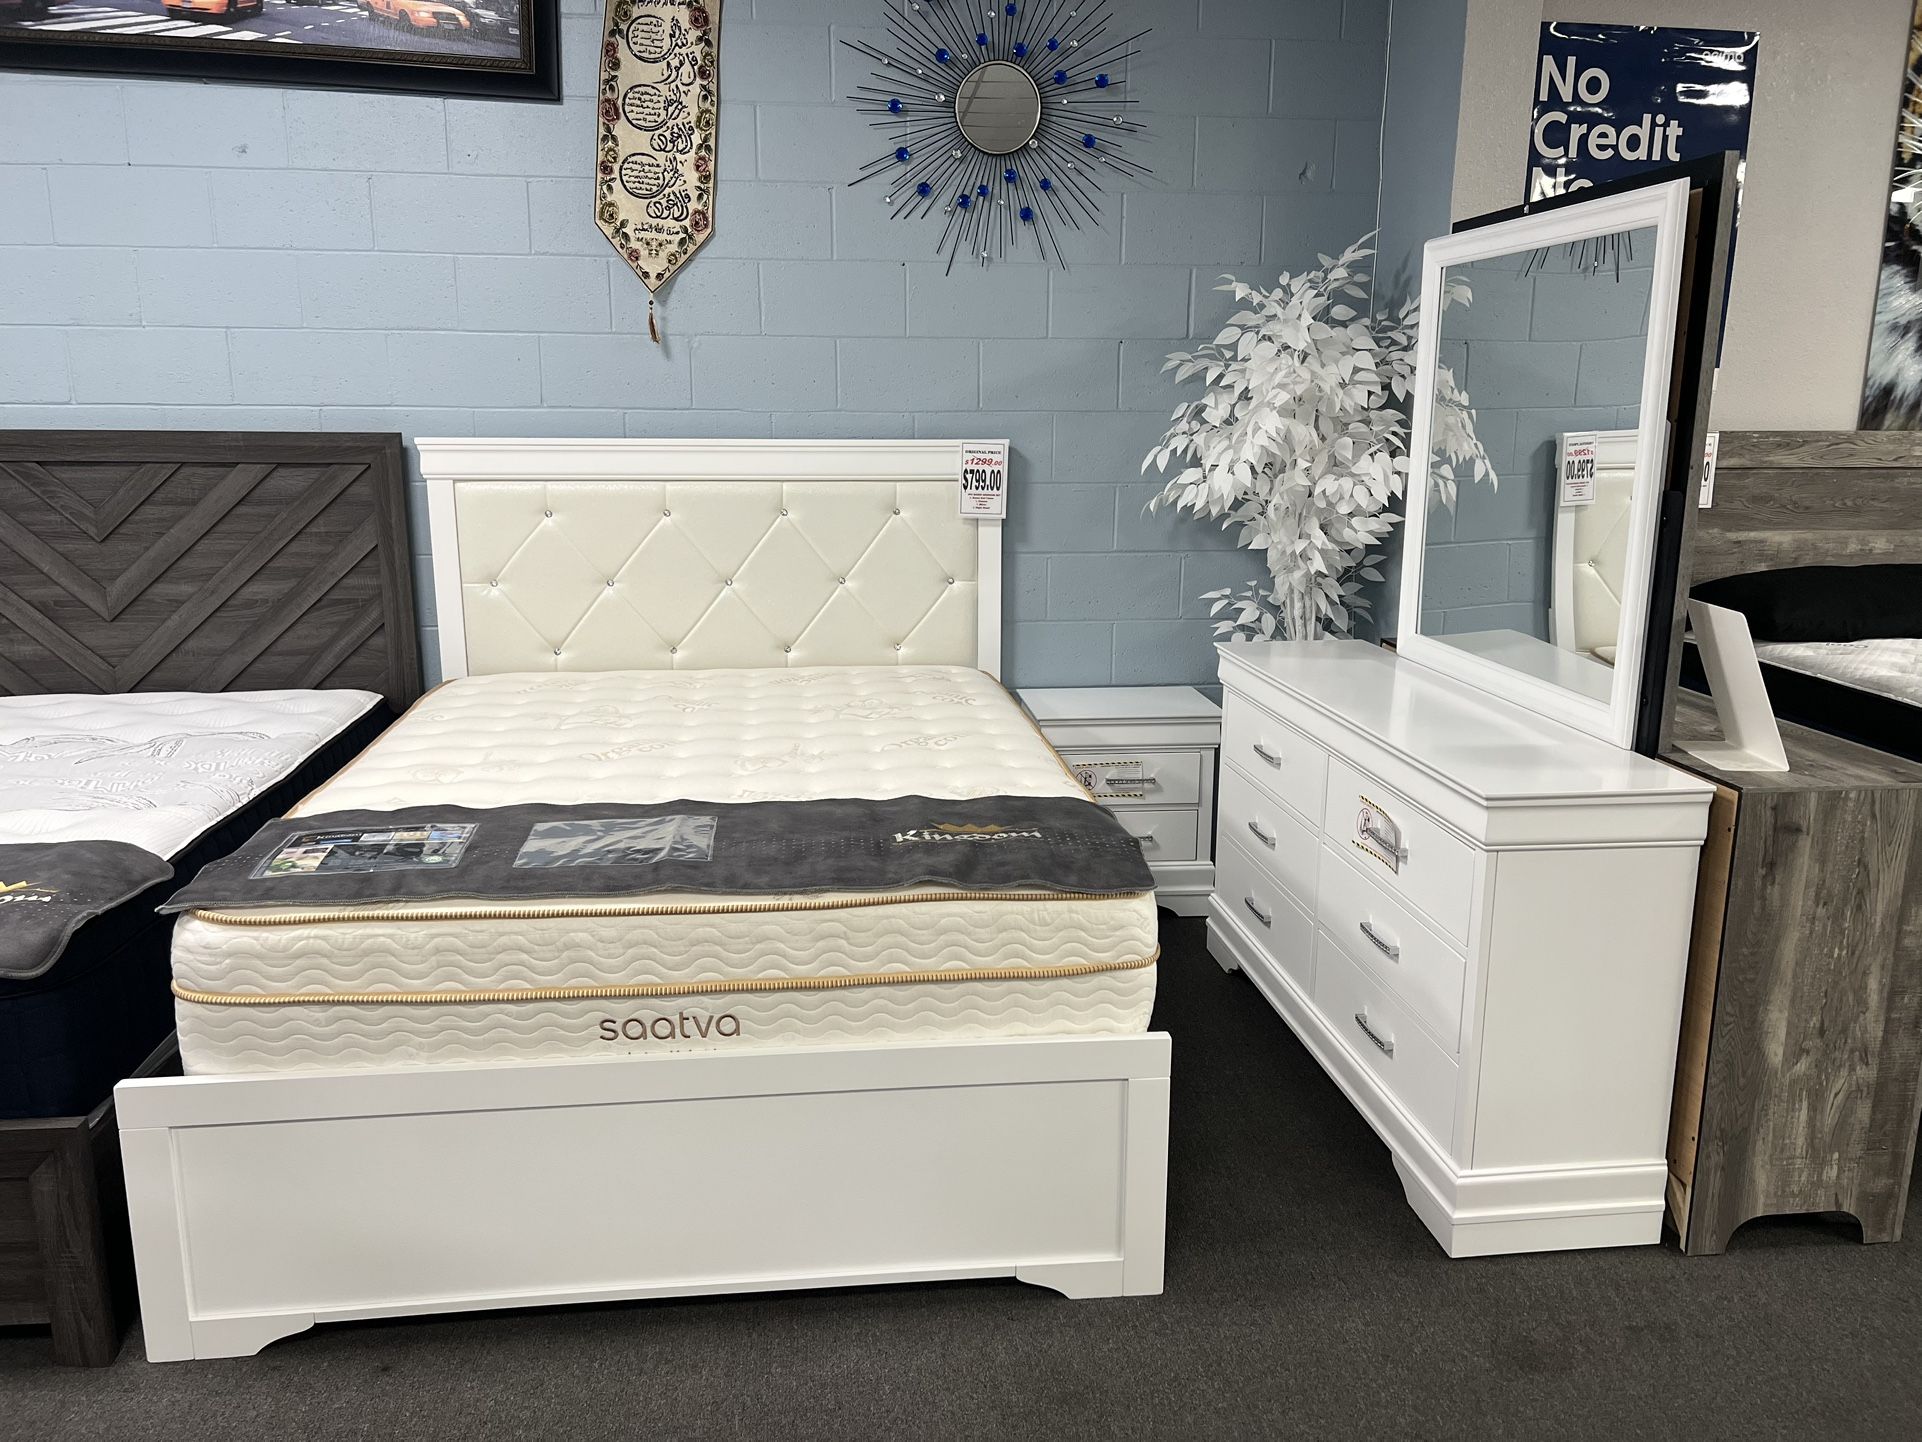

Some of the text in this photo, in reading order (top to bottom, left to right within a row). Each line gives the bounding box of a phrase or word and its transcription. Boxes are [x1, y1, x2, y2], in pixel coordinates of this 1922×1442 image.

[1539, 54, 1610, 104] No
[1534, 111, 1684, 162] Credit
[963, 468, 1001, 492] $799.00
[600, 1011, 741, 1041] saatva
